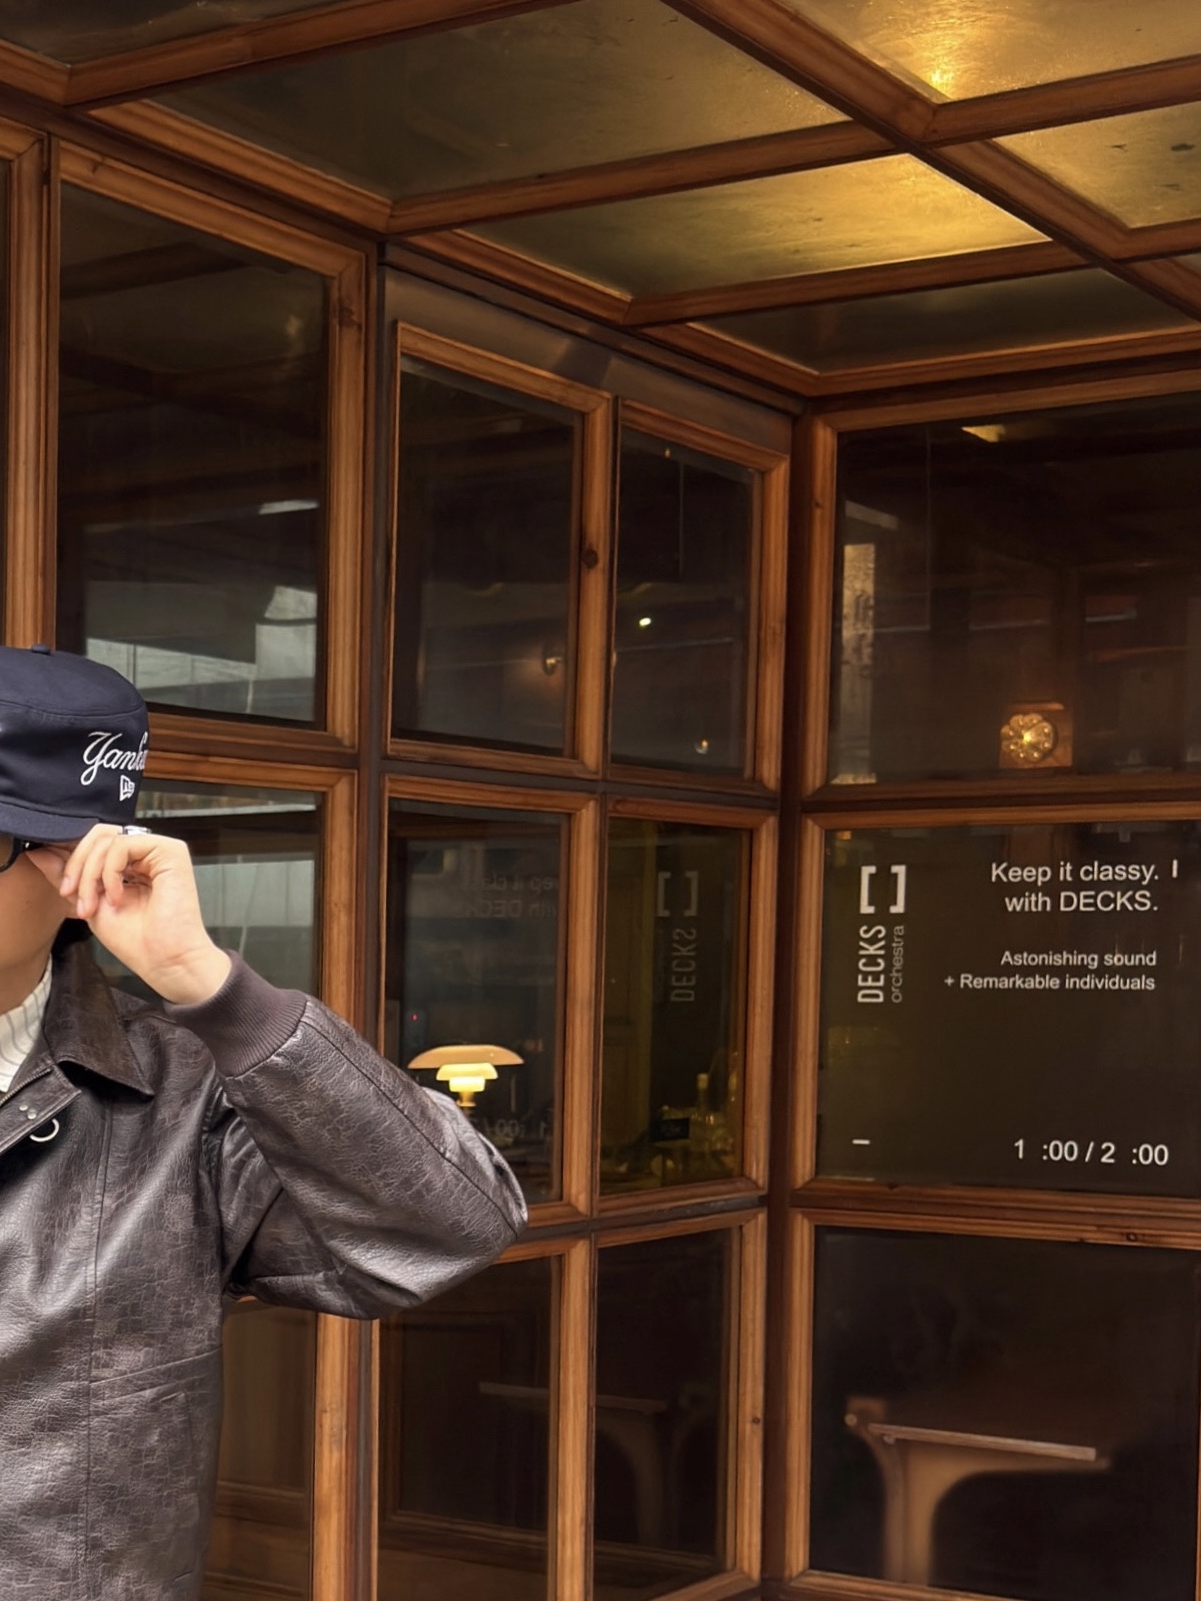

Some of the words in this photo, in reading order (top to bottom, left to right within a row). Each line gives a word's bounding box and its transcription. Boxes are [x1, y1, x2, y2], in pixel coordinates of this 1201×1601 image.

[80, 731, 149, 786] Yank
[991, 862, 1052, 886] Keep
[1059, 861, 1073, 882] it
[1079, 860, 1159, 885] classy.
[1004, 891, 1051, 912] with
[1059, 890, 1158, 912] DECKS.
[857, 925, 886, 1003] DECKS
[890, 925, 905, 1003] orchestra
[1000, 950, 1099, 969] Astonishing
[1103, 950, 1157, 967] sound
[959, 973, 1061, 990] Remarkable
[1065, 973, 1156, 991] individuals
